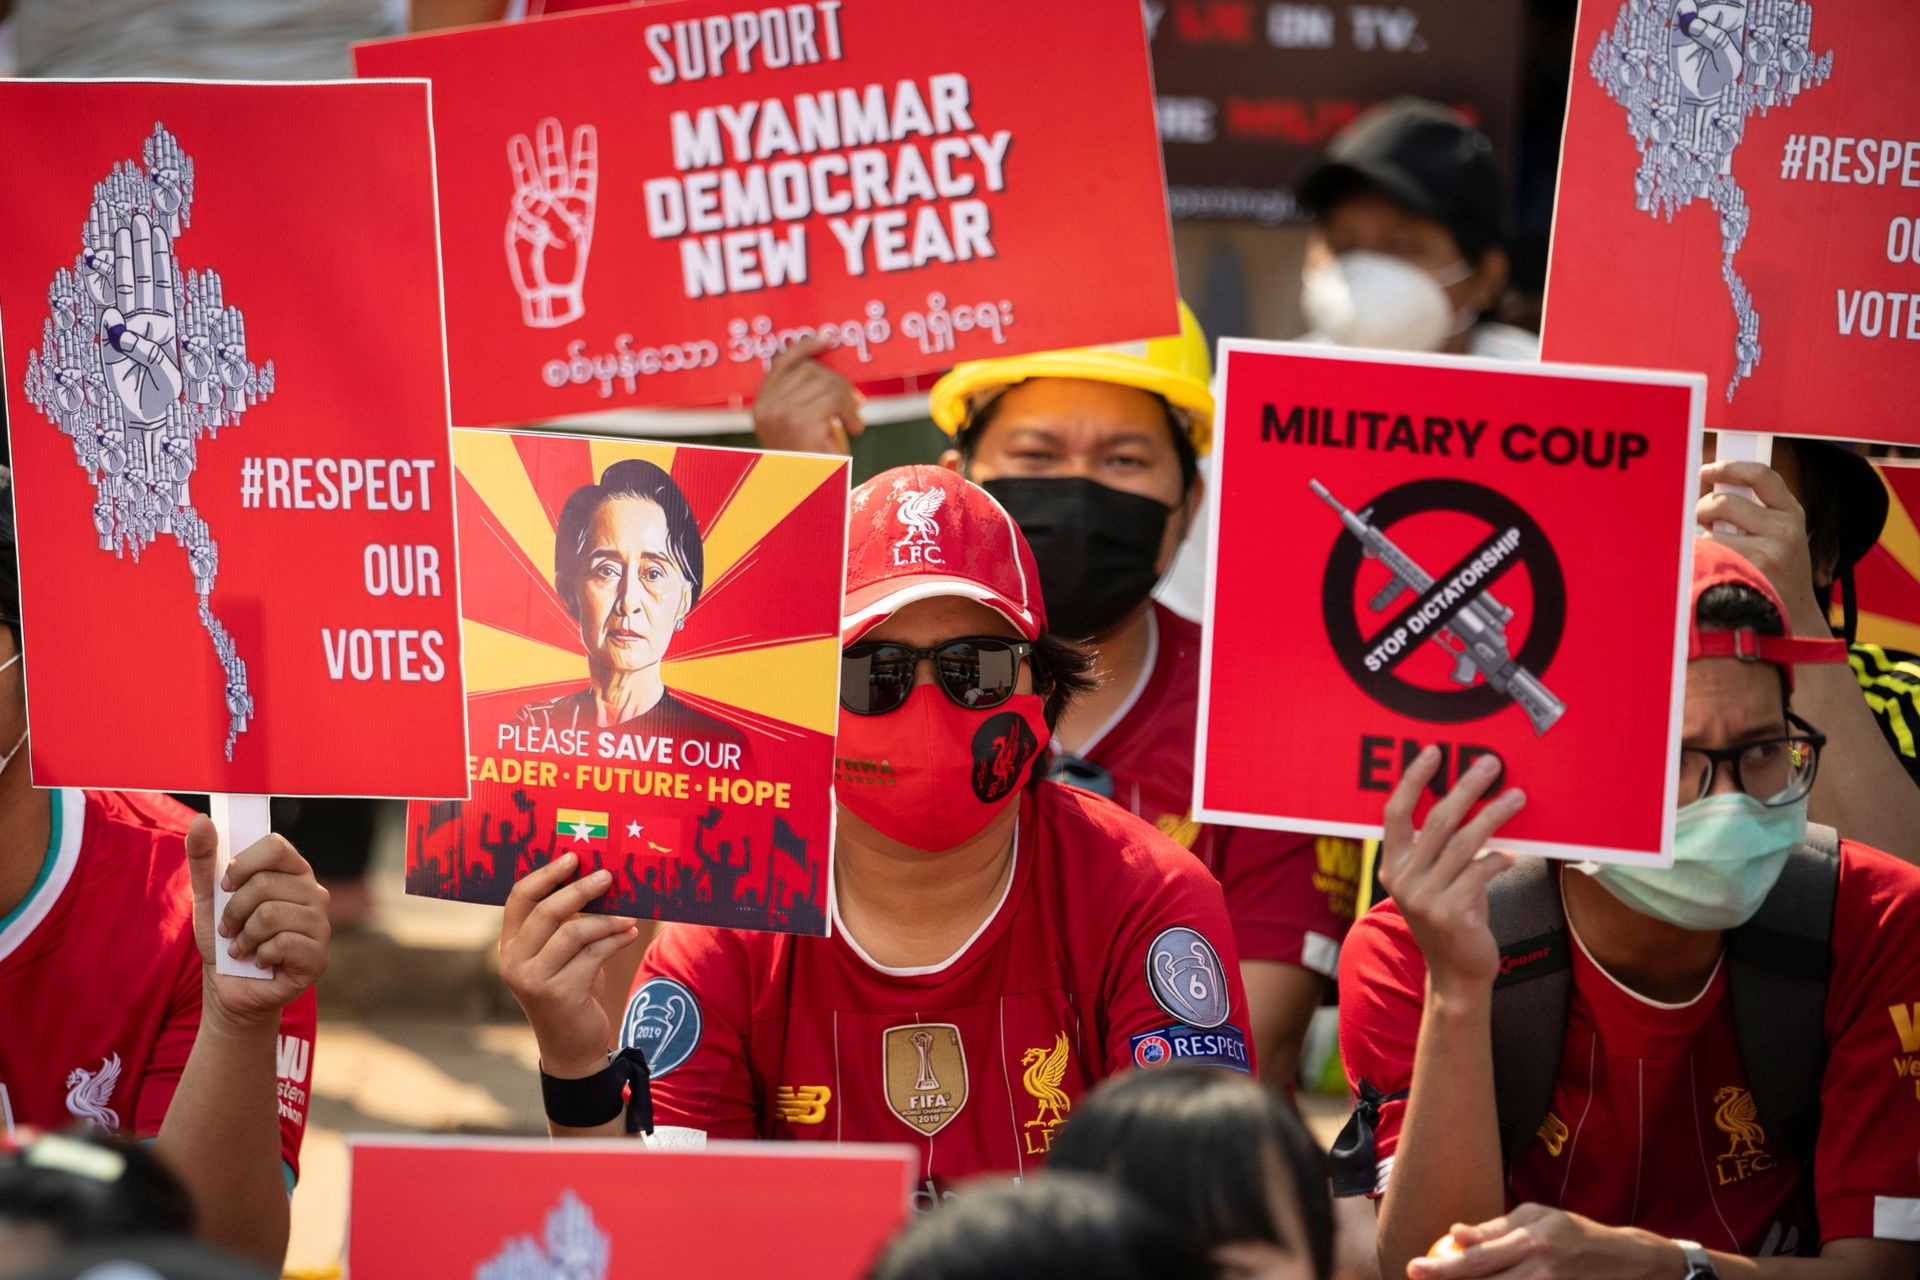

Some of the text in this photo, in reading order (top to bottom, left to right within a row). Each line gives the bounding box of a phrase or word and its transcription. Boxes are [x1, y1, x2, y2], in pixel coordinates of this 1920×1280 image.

[644, 0, 842, 85] SUPPORT
[670, 73, 975, 171] MYANMAR
[643, 131, 1011, 239] DEMOCRACY
[1781, 134, 1920, 188] #RESPE
[680, 199, 996, 298] NEW YEAR
[1837, 289, 1920, 341] VOTE
[1261, 403, 1649, 471] MILITARY COUP
[240, 457, 436, 511] #RESPECT
[363, 544, 441, 597] OUR
[893, 546, 946, 566] L.F.C.
[1364, 526, 1521, 672] STOP DICTATORSHIP
[321, 628, 446, 682] VOTES
[498, 724, 741, 770] PLEASE SAVE OUR
[470, 756, 792, 809] EADER FUTURE HOPE
[1189, 974, 1208, 1000] 6
[636, 1026, 662, 1038] 2019
[1174, 1036, 1246, 1061] RESPECT
[277, 1081, 306, 1106] stern
[910, 1093, 947, 1109] FIFA
[918, 1114, 940, 1123] 2019
[1716, 1154, 1777, 1185] L.F.C.
